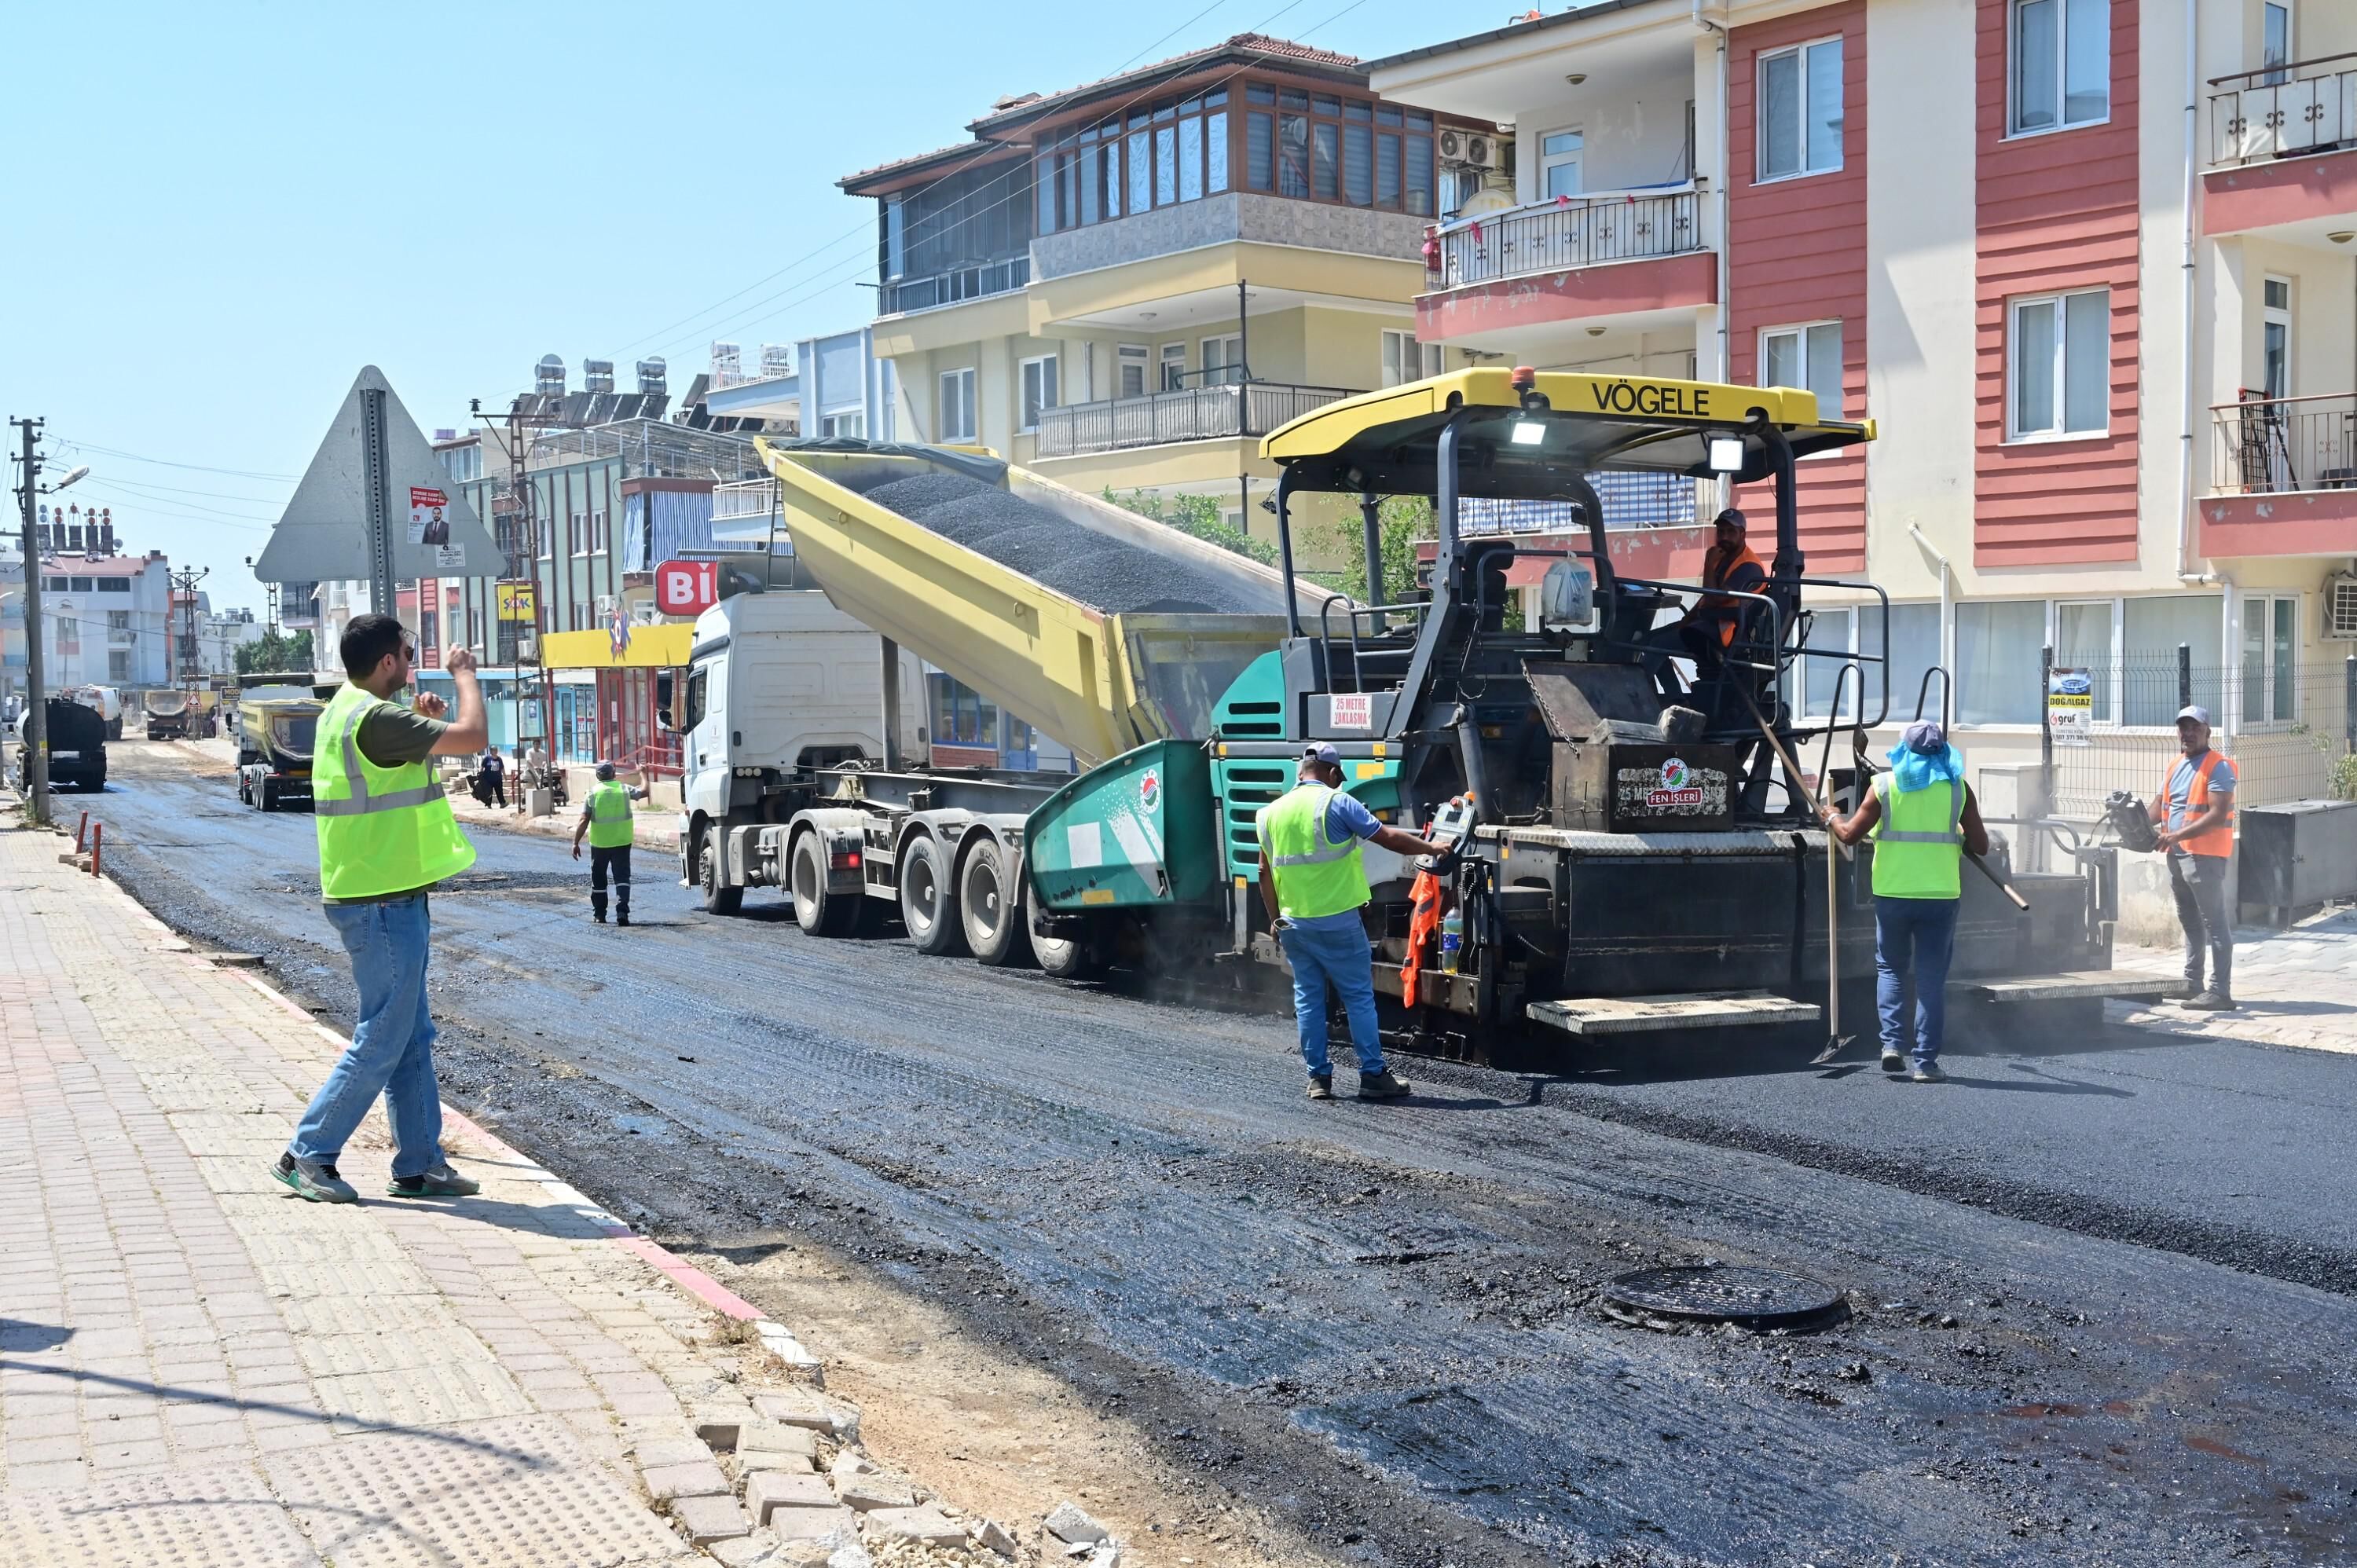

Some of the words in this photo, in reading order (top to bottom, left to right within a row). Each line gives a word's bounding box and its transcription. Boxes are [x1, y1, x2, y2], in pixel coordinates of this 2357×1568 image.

[1592, 379, 1710, 416] VÖGELE
[667, 562, 710, 605] Bİ
[504, 595, 530, 612] ŞOK
[1336, 698, 1344, 710] 25
[1345, 698, 1365, 711] METRE
[2050, 697, 2091, 706] DOĞALGAZ
[1335, 713, 1367, 725] YAKLAŞMA
[2058, 713, 2077, 726] gruf
[1651, 793, 1669, 804] FEN
[1670, 791, 1699, 804] İŞLERİ
